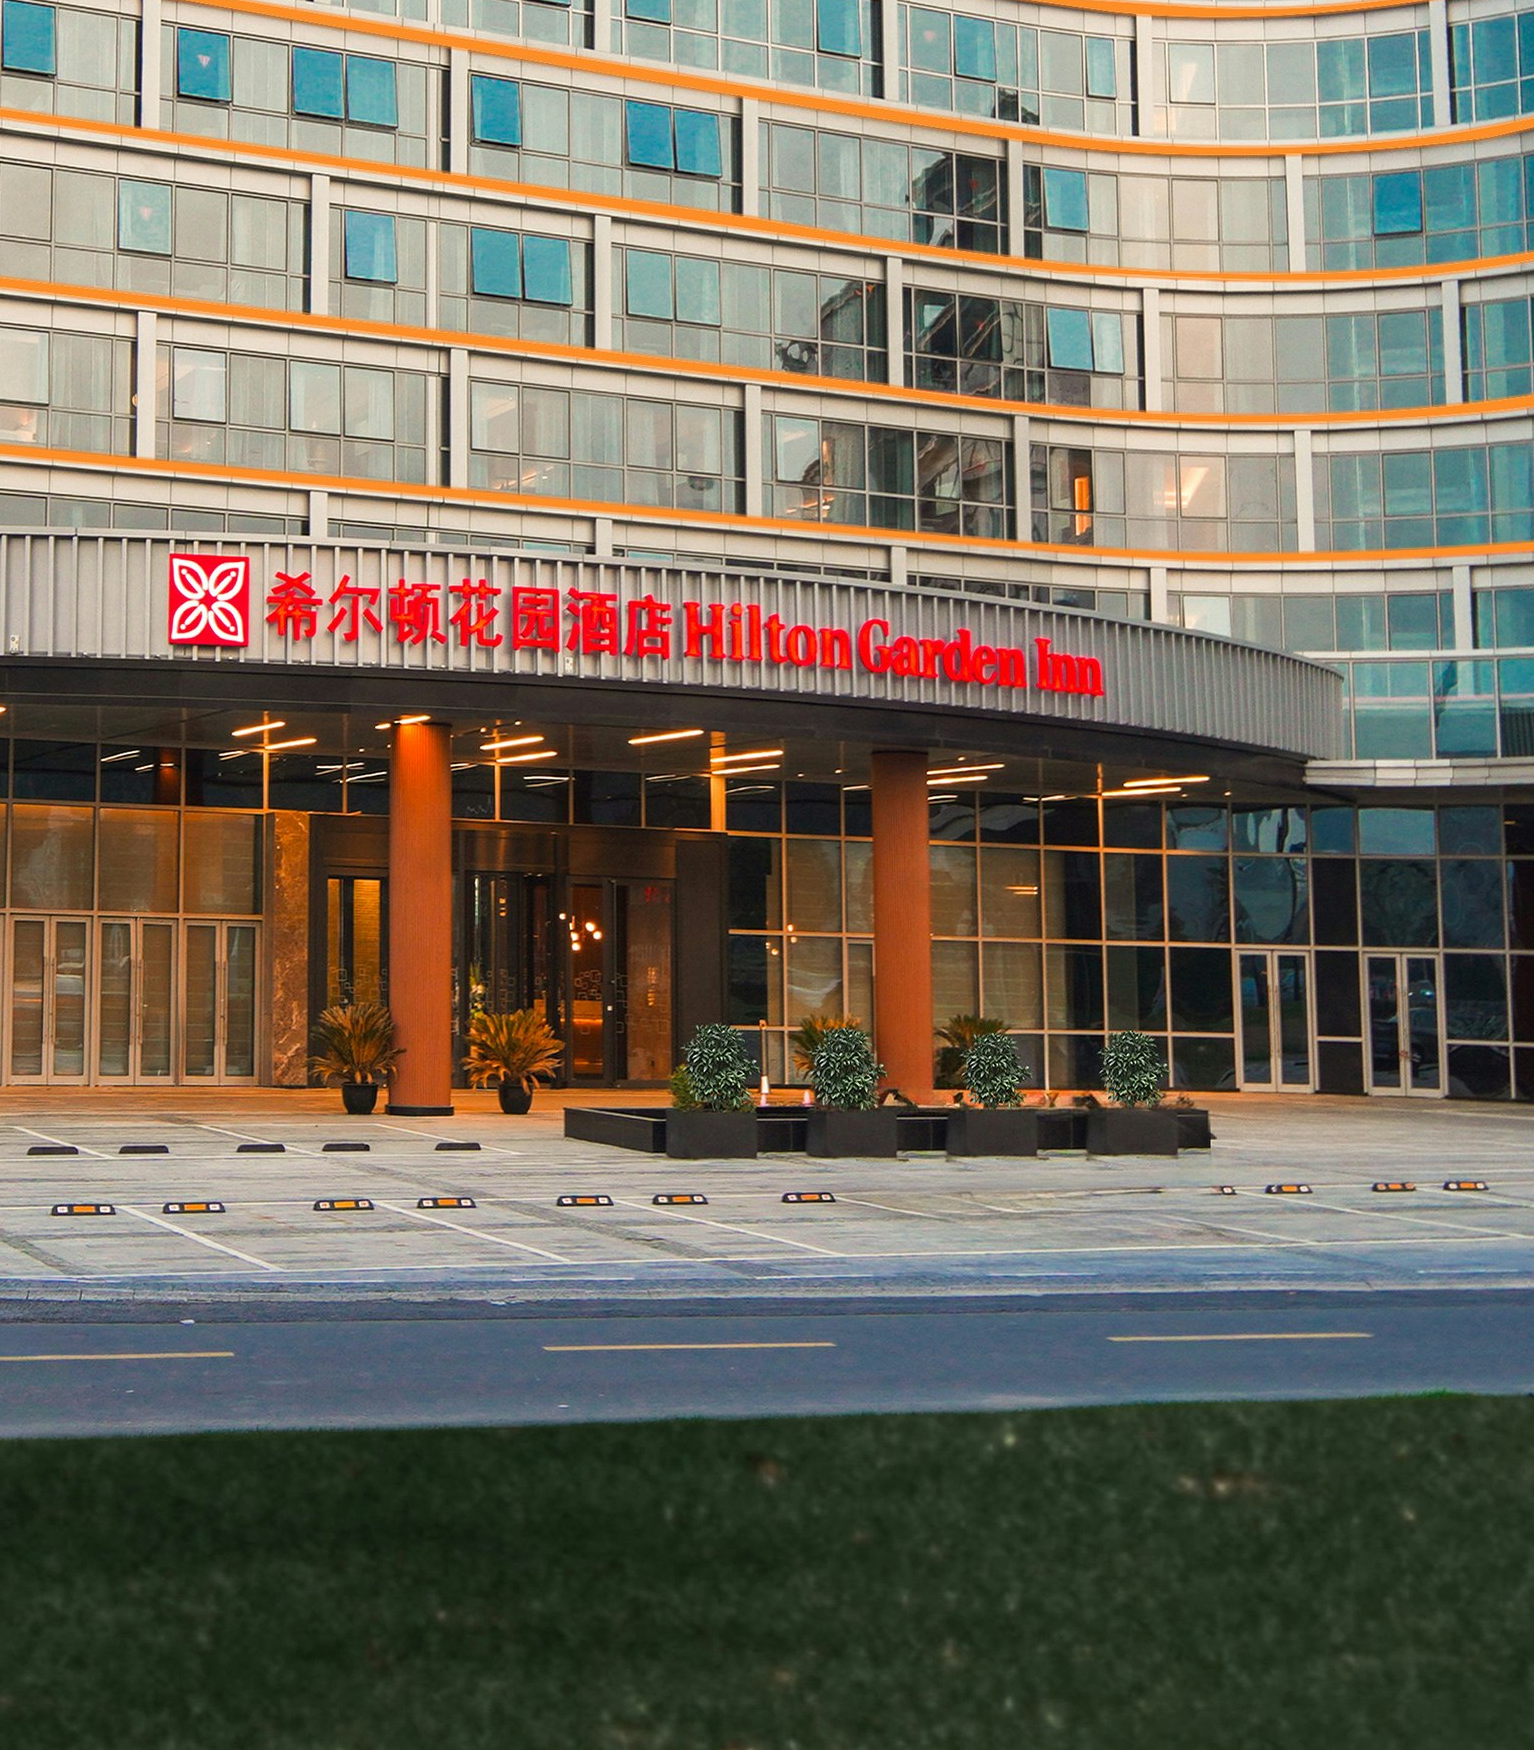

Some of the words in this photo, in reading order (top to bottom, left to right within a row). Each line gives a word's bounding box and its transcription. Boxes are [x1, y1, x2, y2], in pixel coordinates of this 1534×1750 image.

[265, 571, 673, 661] 希尔顿花园酒店
[683, 600, 854, 671] Hilton
[856, 617, 1028, 689] Garden
[1034, 636, 1106, 698] Inn
